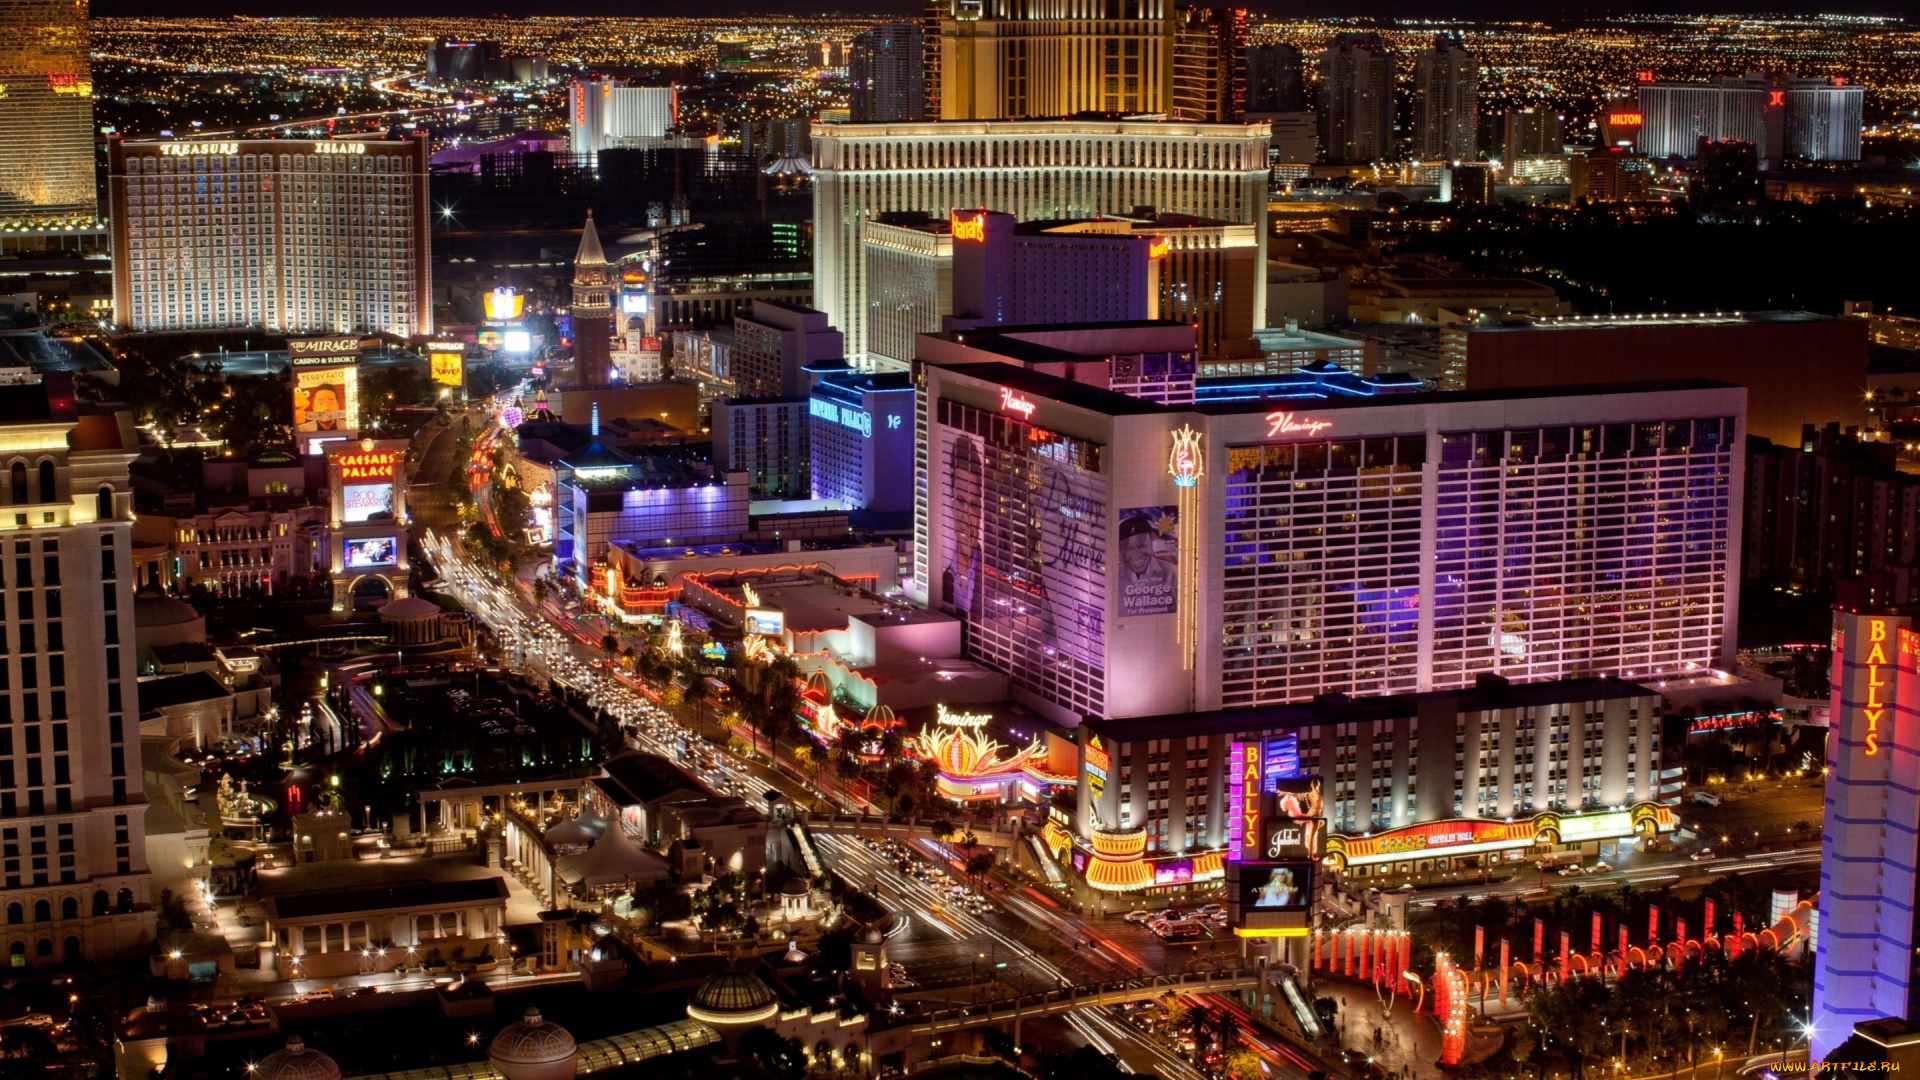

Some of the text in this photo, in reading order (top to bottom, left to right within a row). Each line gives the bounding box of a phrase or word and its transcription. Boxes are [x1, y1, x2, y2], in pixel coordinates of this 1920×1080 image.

[1609, 114, 1642, 125] HILTON
[160, 142, 366, 156] TREASURE ISLAND
[306, 340, 358, 352] MIRAGE
[302, 374, 325, 382] TERRY
[1001, 387, 1036, 421] Flamingo
[1265, 411, 1332, 437] Flamingo
[339, 453, 395, 466] CAESARS
[342, 466, 393, 478] PALACE
[353, 490, 376, 500] ROD
[346, 499, 383, 508] STEWART
[1125, 583, 1171, 596] George
[1123, 595, 1173, 608] Wallace
[1127, 606, 1168, 615] For President
[1863, 619, 1887, 756] BALLYS
[938, 703, 993, 734] Flamingo
[1244, 747, 1259, 847] BALLYS
[1457, 831, 1473, 841] HALL
[1267, 828, 1301, 858] Jubilee!
